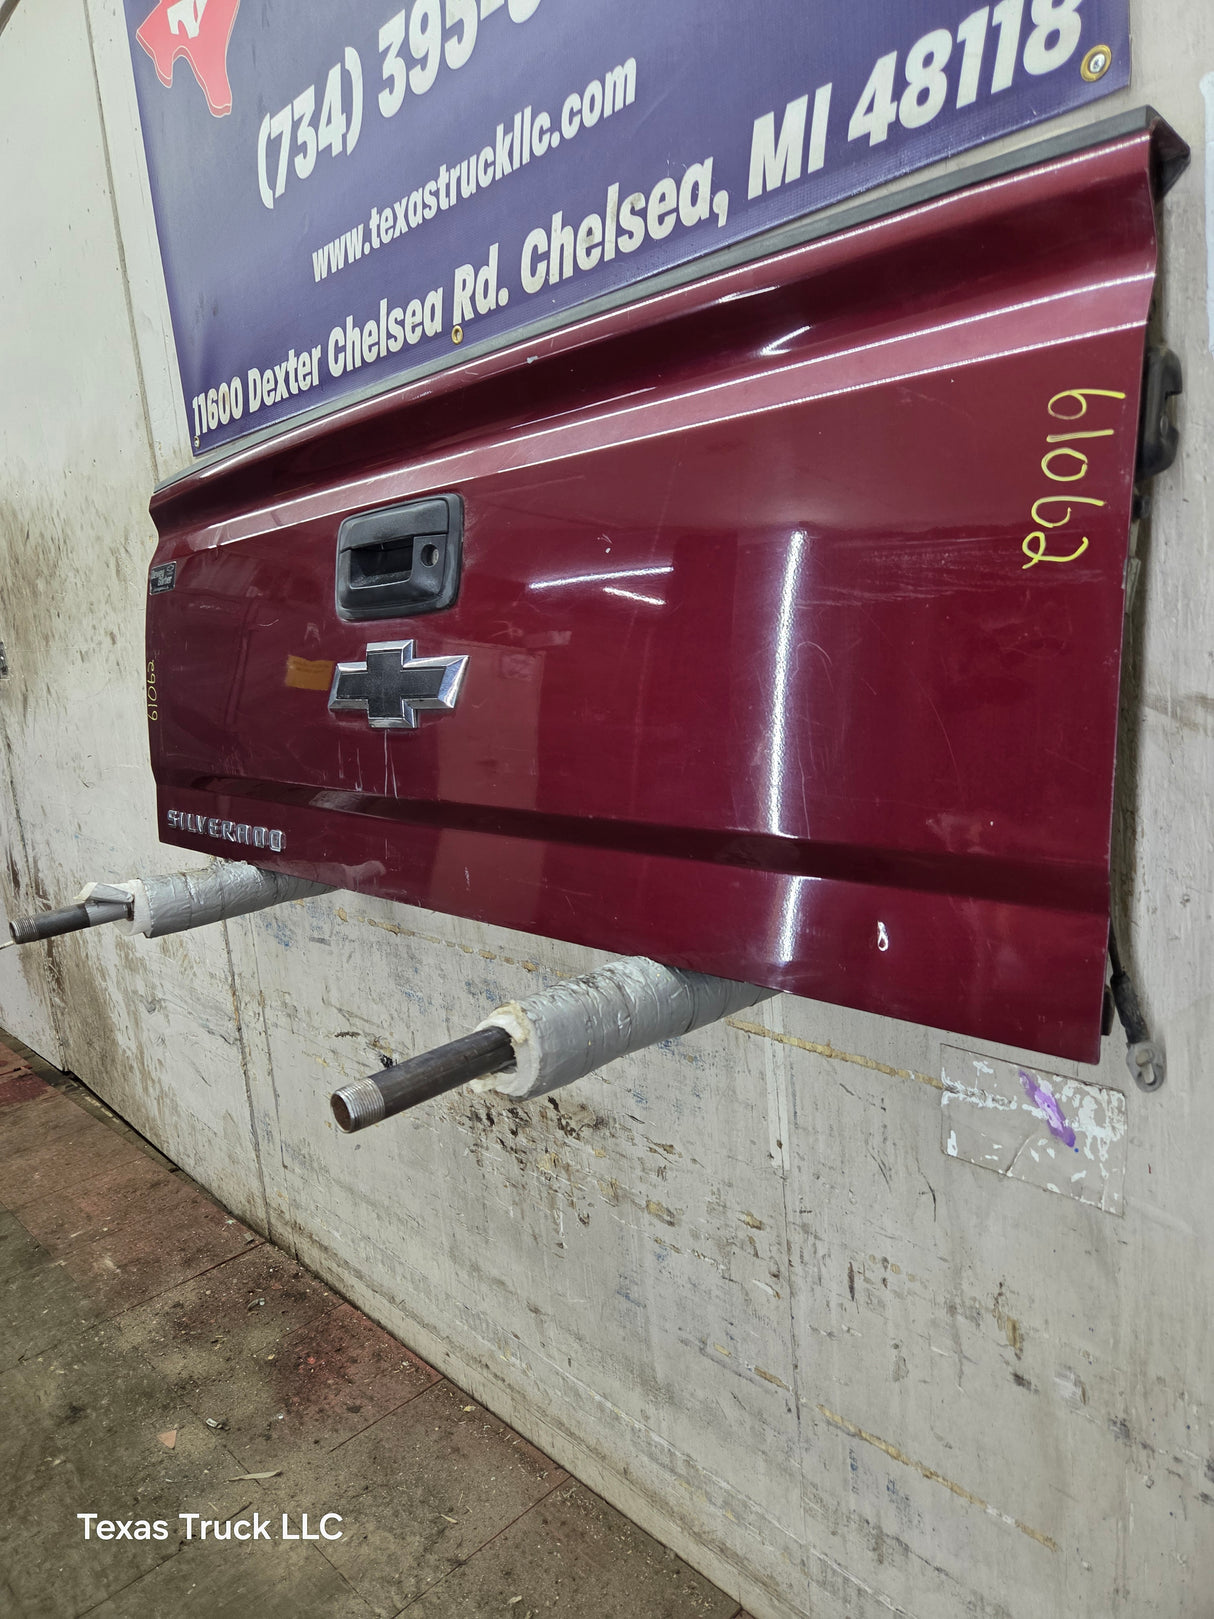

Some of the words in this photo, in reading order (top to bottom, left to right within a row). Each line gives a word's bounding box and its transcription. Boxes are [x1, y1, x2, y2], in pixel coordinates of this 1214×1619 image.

[257, 46, 364, 210] (734)
[378, 0, 542, 118] 395-
[311, 57, 637, 283] www.texastruckllc.com
[192, 376, 244, 437] 11600
[247, 344, 322, 413] Dexter
[327, 286, 444, 378] Chelsea
[452, 242, 509, 326] Rd.
[520, 155, 730, 294] Chelsea,
[747, 82, 833, 200] MI
[847, 0, 1082, 147] 48118
[166, 809, 285, 852] SILVERADO
